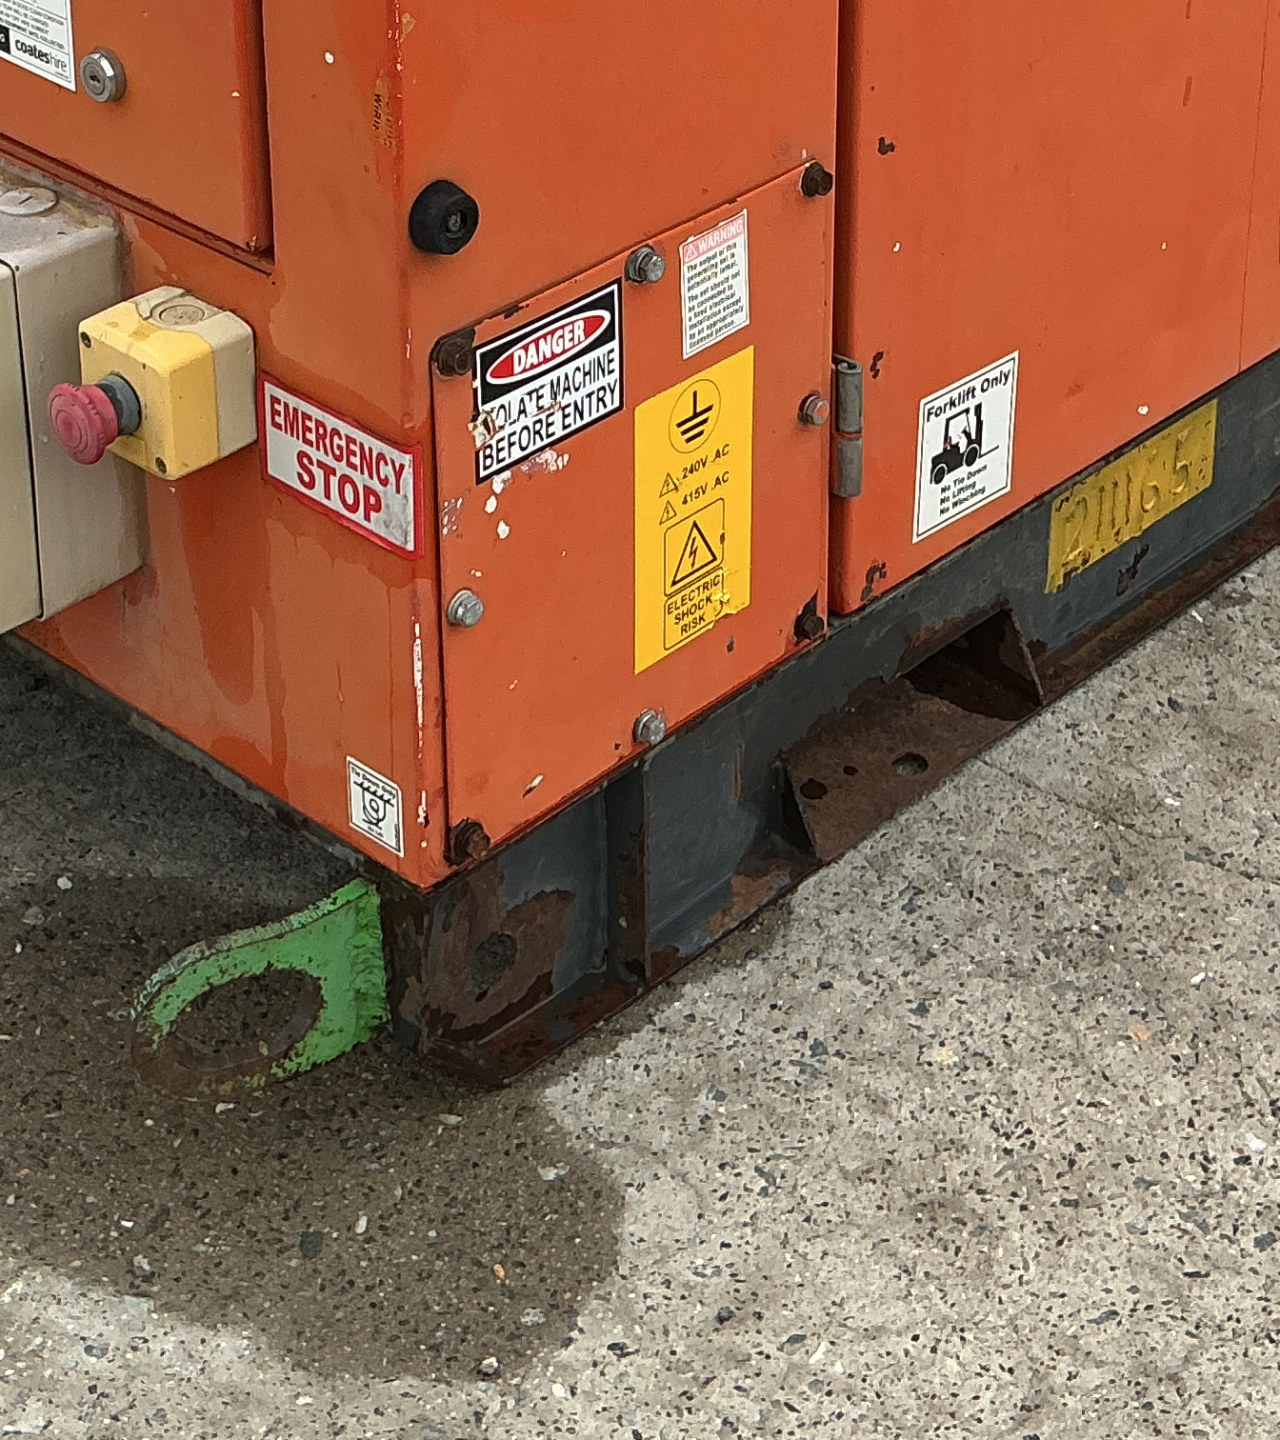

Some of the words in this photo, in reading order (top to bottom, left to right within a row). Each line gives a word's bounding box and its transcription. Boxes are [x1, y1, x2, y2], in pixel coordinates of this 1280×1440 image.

[14, 38, 68, 73] coateshire
[698, 220, 743, 253] WARNING
[513, 319, 587, 375] DANGER
[549, 347, 616, 403] MACHINE
[926, 386, 977, 423] Forklift
[980, 368, 1012, 393] Only
[482, 414, 556, 472] BEFORE
[561, 378, 619, 432] ENTRY
[270, 394, 406, 495] EMERGENCY
[681, 455, 709, 480] 240V
[713, 443, 730, 462] AC
[296, 449, 383, 524] STOP
[681, 483, 708, 505] 415V
[713, 471, 730, 489] AC
[939, 495, 950, 507] No
[952, 481, 977, 502] Lifting
[940, 483, 951, 495] No
[952, 474, 965, 488] Tie
[966, 464, 988, 483] Down
[939, 505, 950, 517] No
[951, 485, 986, 511] Winching
[667, 574, 720, 615] ELECTRIC
[674, 595, 714, 626] SHOCK
[680, 614, 706, 637] RISK
